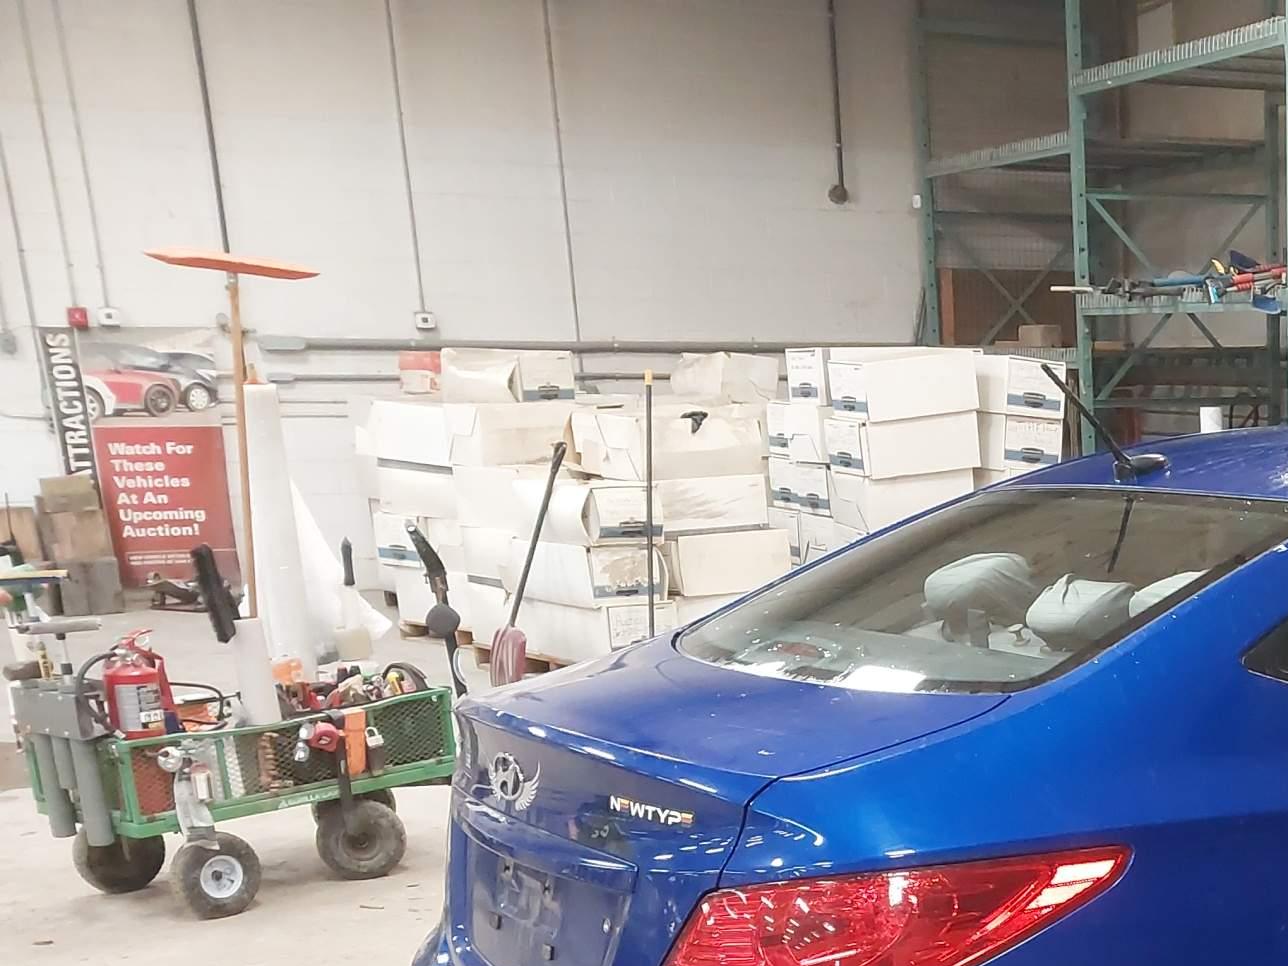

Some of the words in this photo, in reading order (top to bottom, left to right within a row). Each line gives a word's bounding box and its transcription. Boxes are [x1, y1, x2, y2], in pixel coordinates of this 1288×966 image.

[108, 442, 162, 455] Watch
[165, 442, 194, 455] For
[110, 459, 165, 472] These
[113, 475, 191, 489] Vehicles
[117, 492, 138, 505] At
[143, 492, 169, 504] An
[119, 508, 206, 522] Upcoming
[122, 525, 200, 538] Auction!
